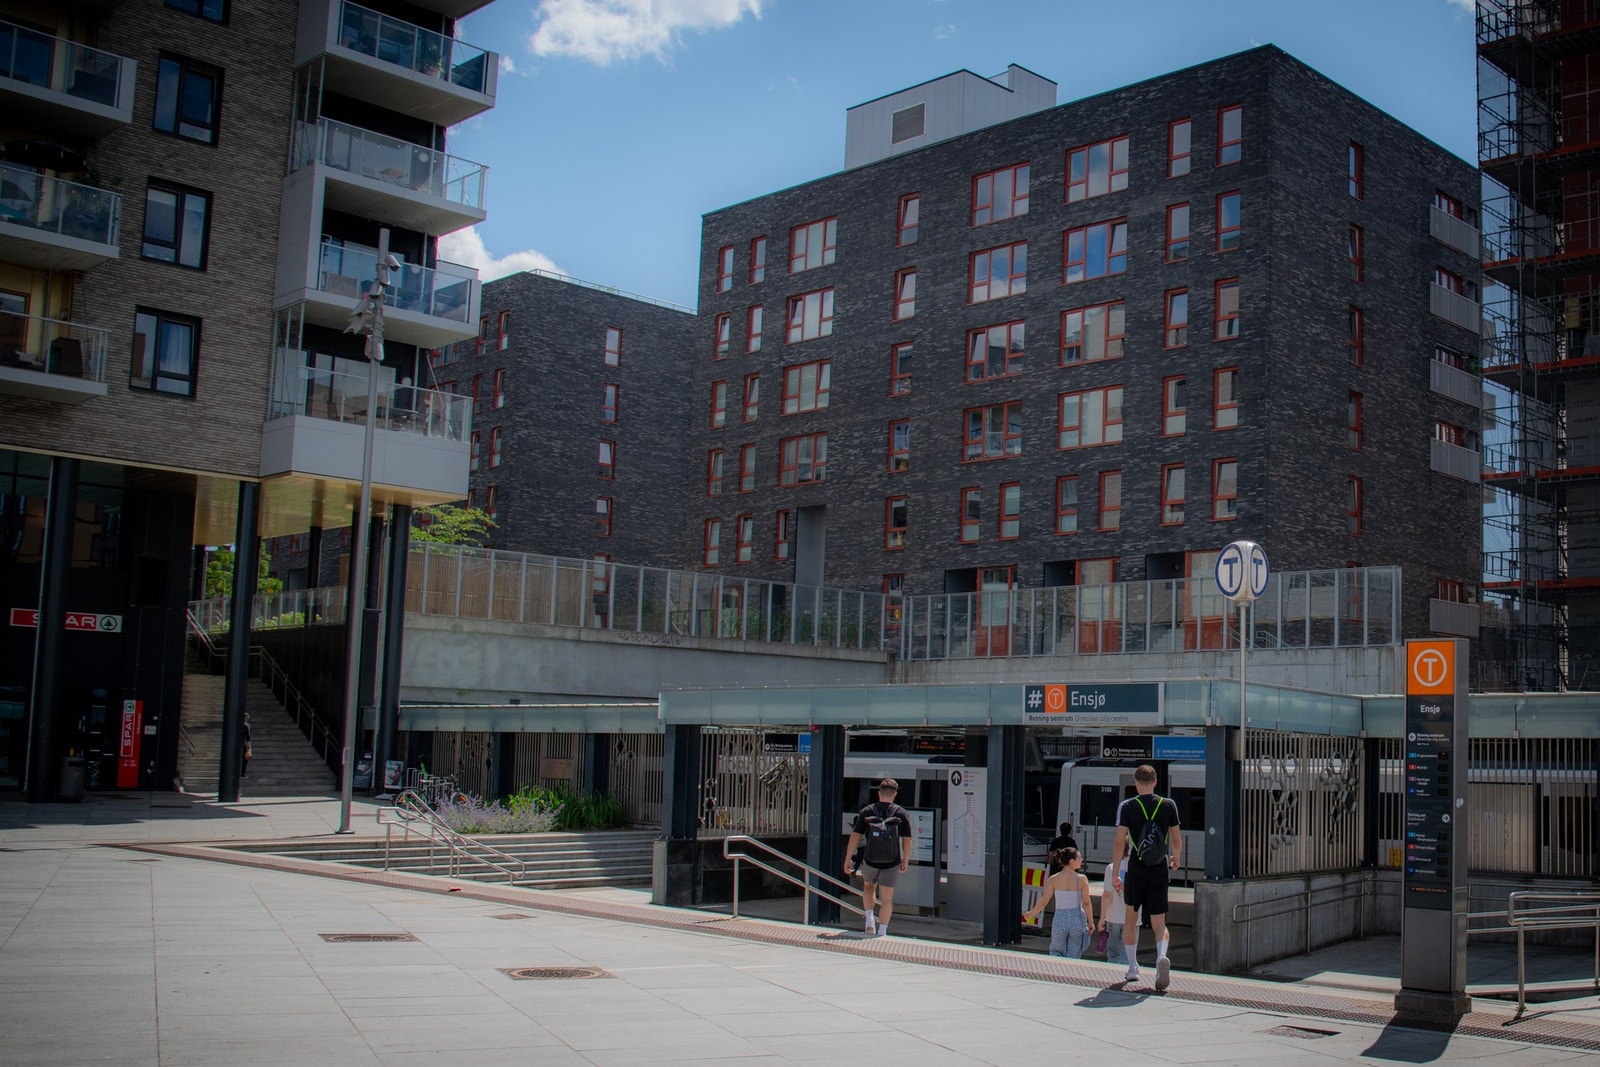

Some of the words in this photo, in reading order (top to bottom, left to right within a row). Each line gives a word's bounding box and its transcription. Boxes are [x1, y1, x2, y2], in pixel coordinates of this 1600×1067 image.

[1223, 557, 1238, 588] T
[33, 612, 96, 627] SAR
[1423, 657, 1438, 682] T
[1071, 691, 1106, 709] Ensjø
[1420, 704, 1440, 714] Ensjø
[1028, 715, 1049, 723] Retning
[1099, 715, 1110, 724] city
[124, 714, 133, 747] SPAR
